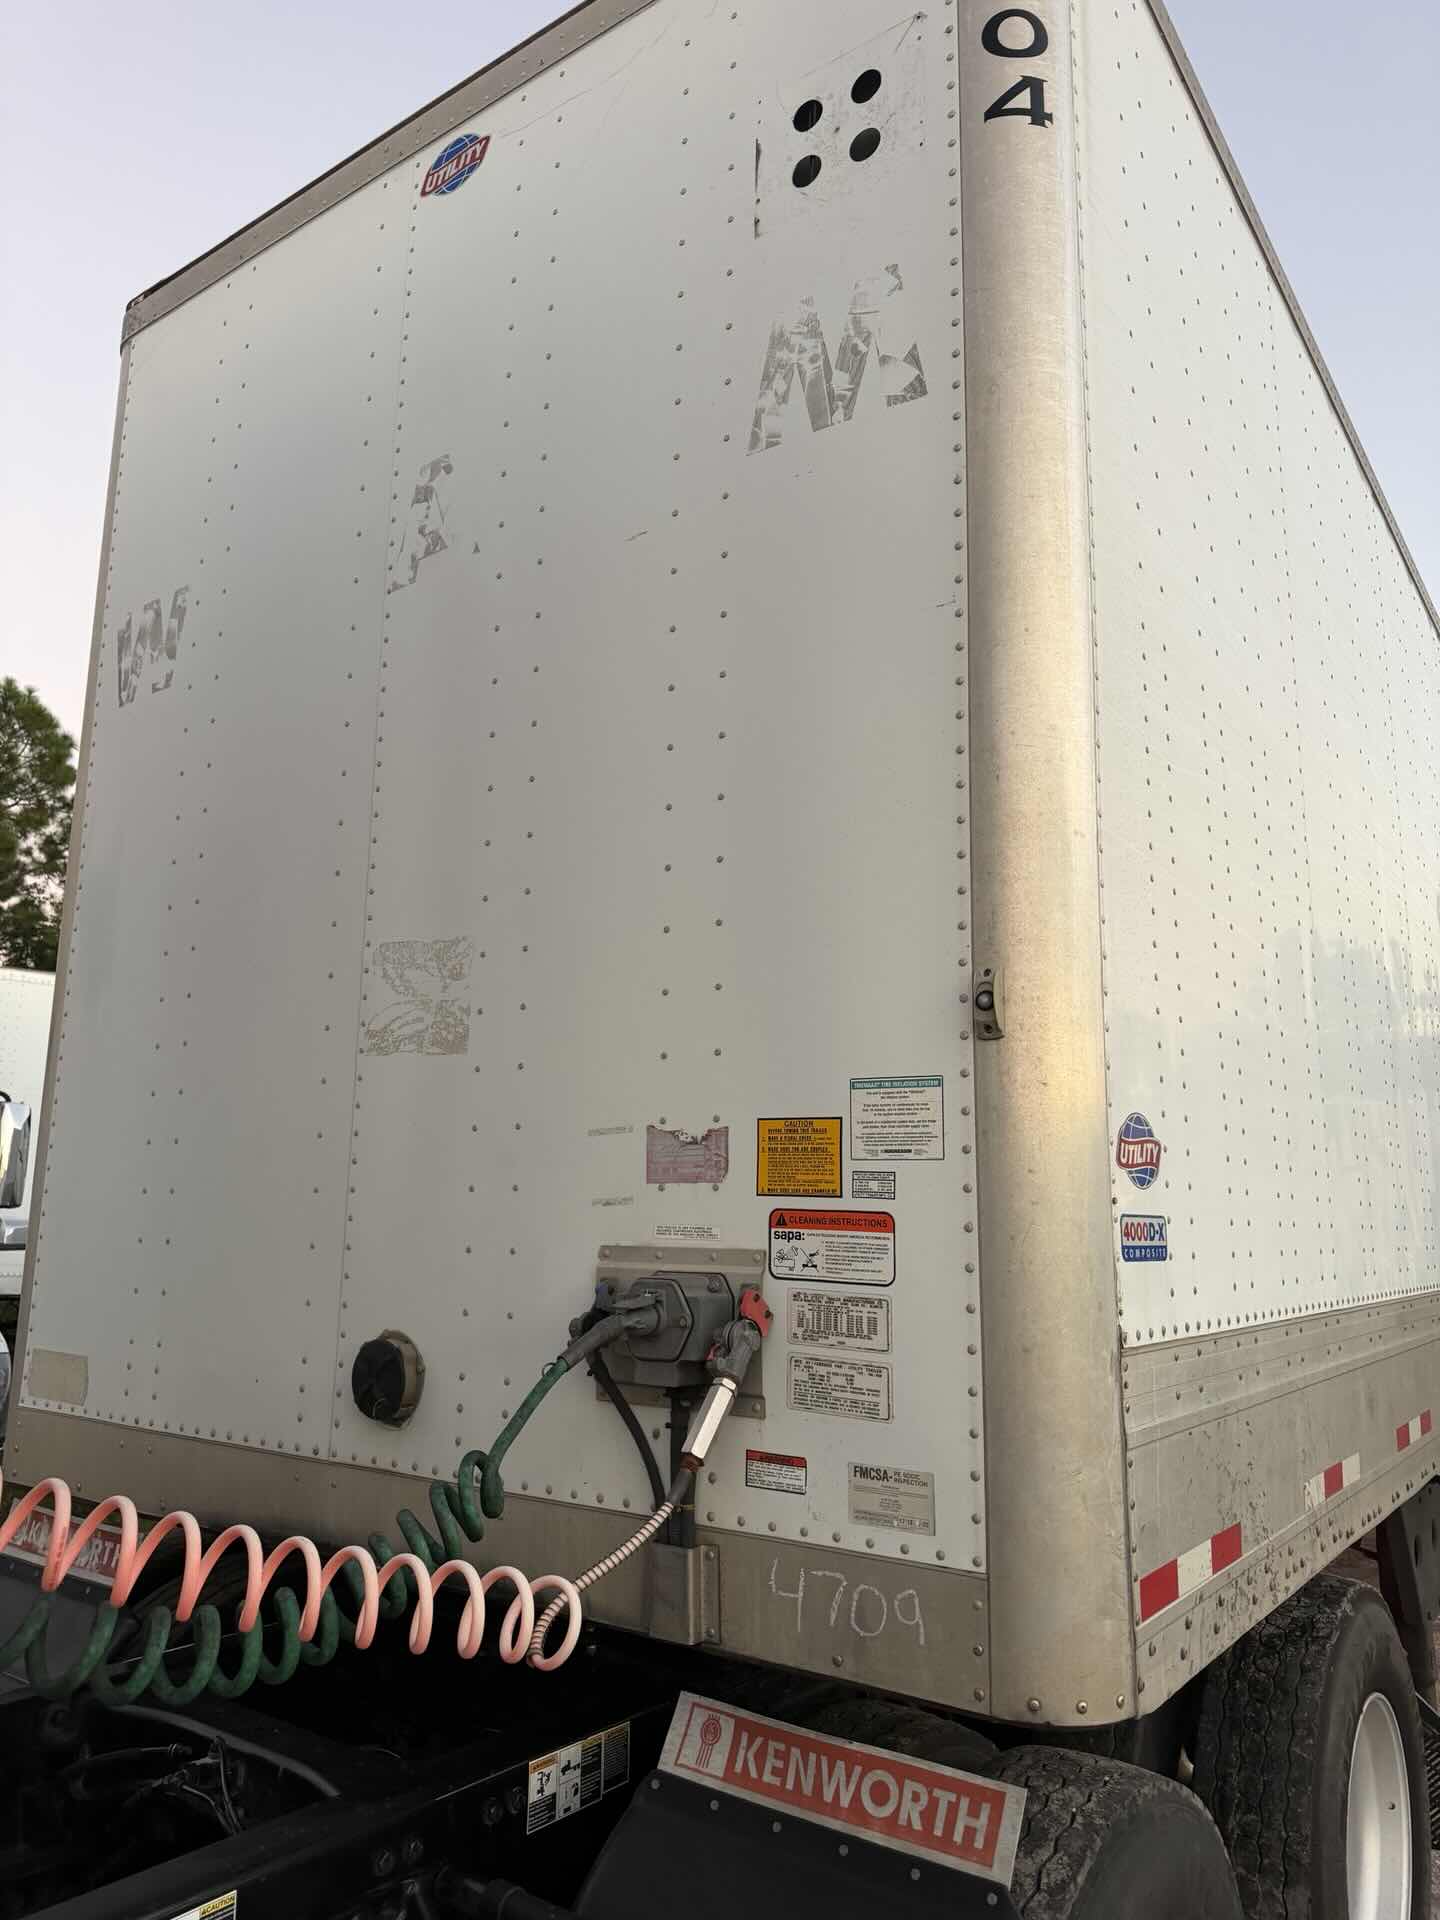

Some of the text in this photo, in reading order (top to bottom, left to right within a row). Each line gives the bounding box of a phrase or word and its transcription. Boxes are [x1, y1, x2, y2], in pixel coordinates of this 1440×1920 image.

[424, 139, 486, 193] UTILITY
[1119, 1142, 1160, 1164] UTILITY
[789, 1215, 888, 1228] CLEANING INSTRUCTIONS
[1124, 1247, 1167, 1259] COMPOSITE
[768, 1557, 926, 1646] 4709
[733, 1729, 992, 1850] KENWORTH
[206, 1895, 236, 1913] CAUTION
